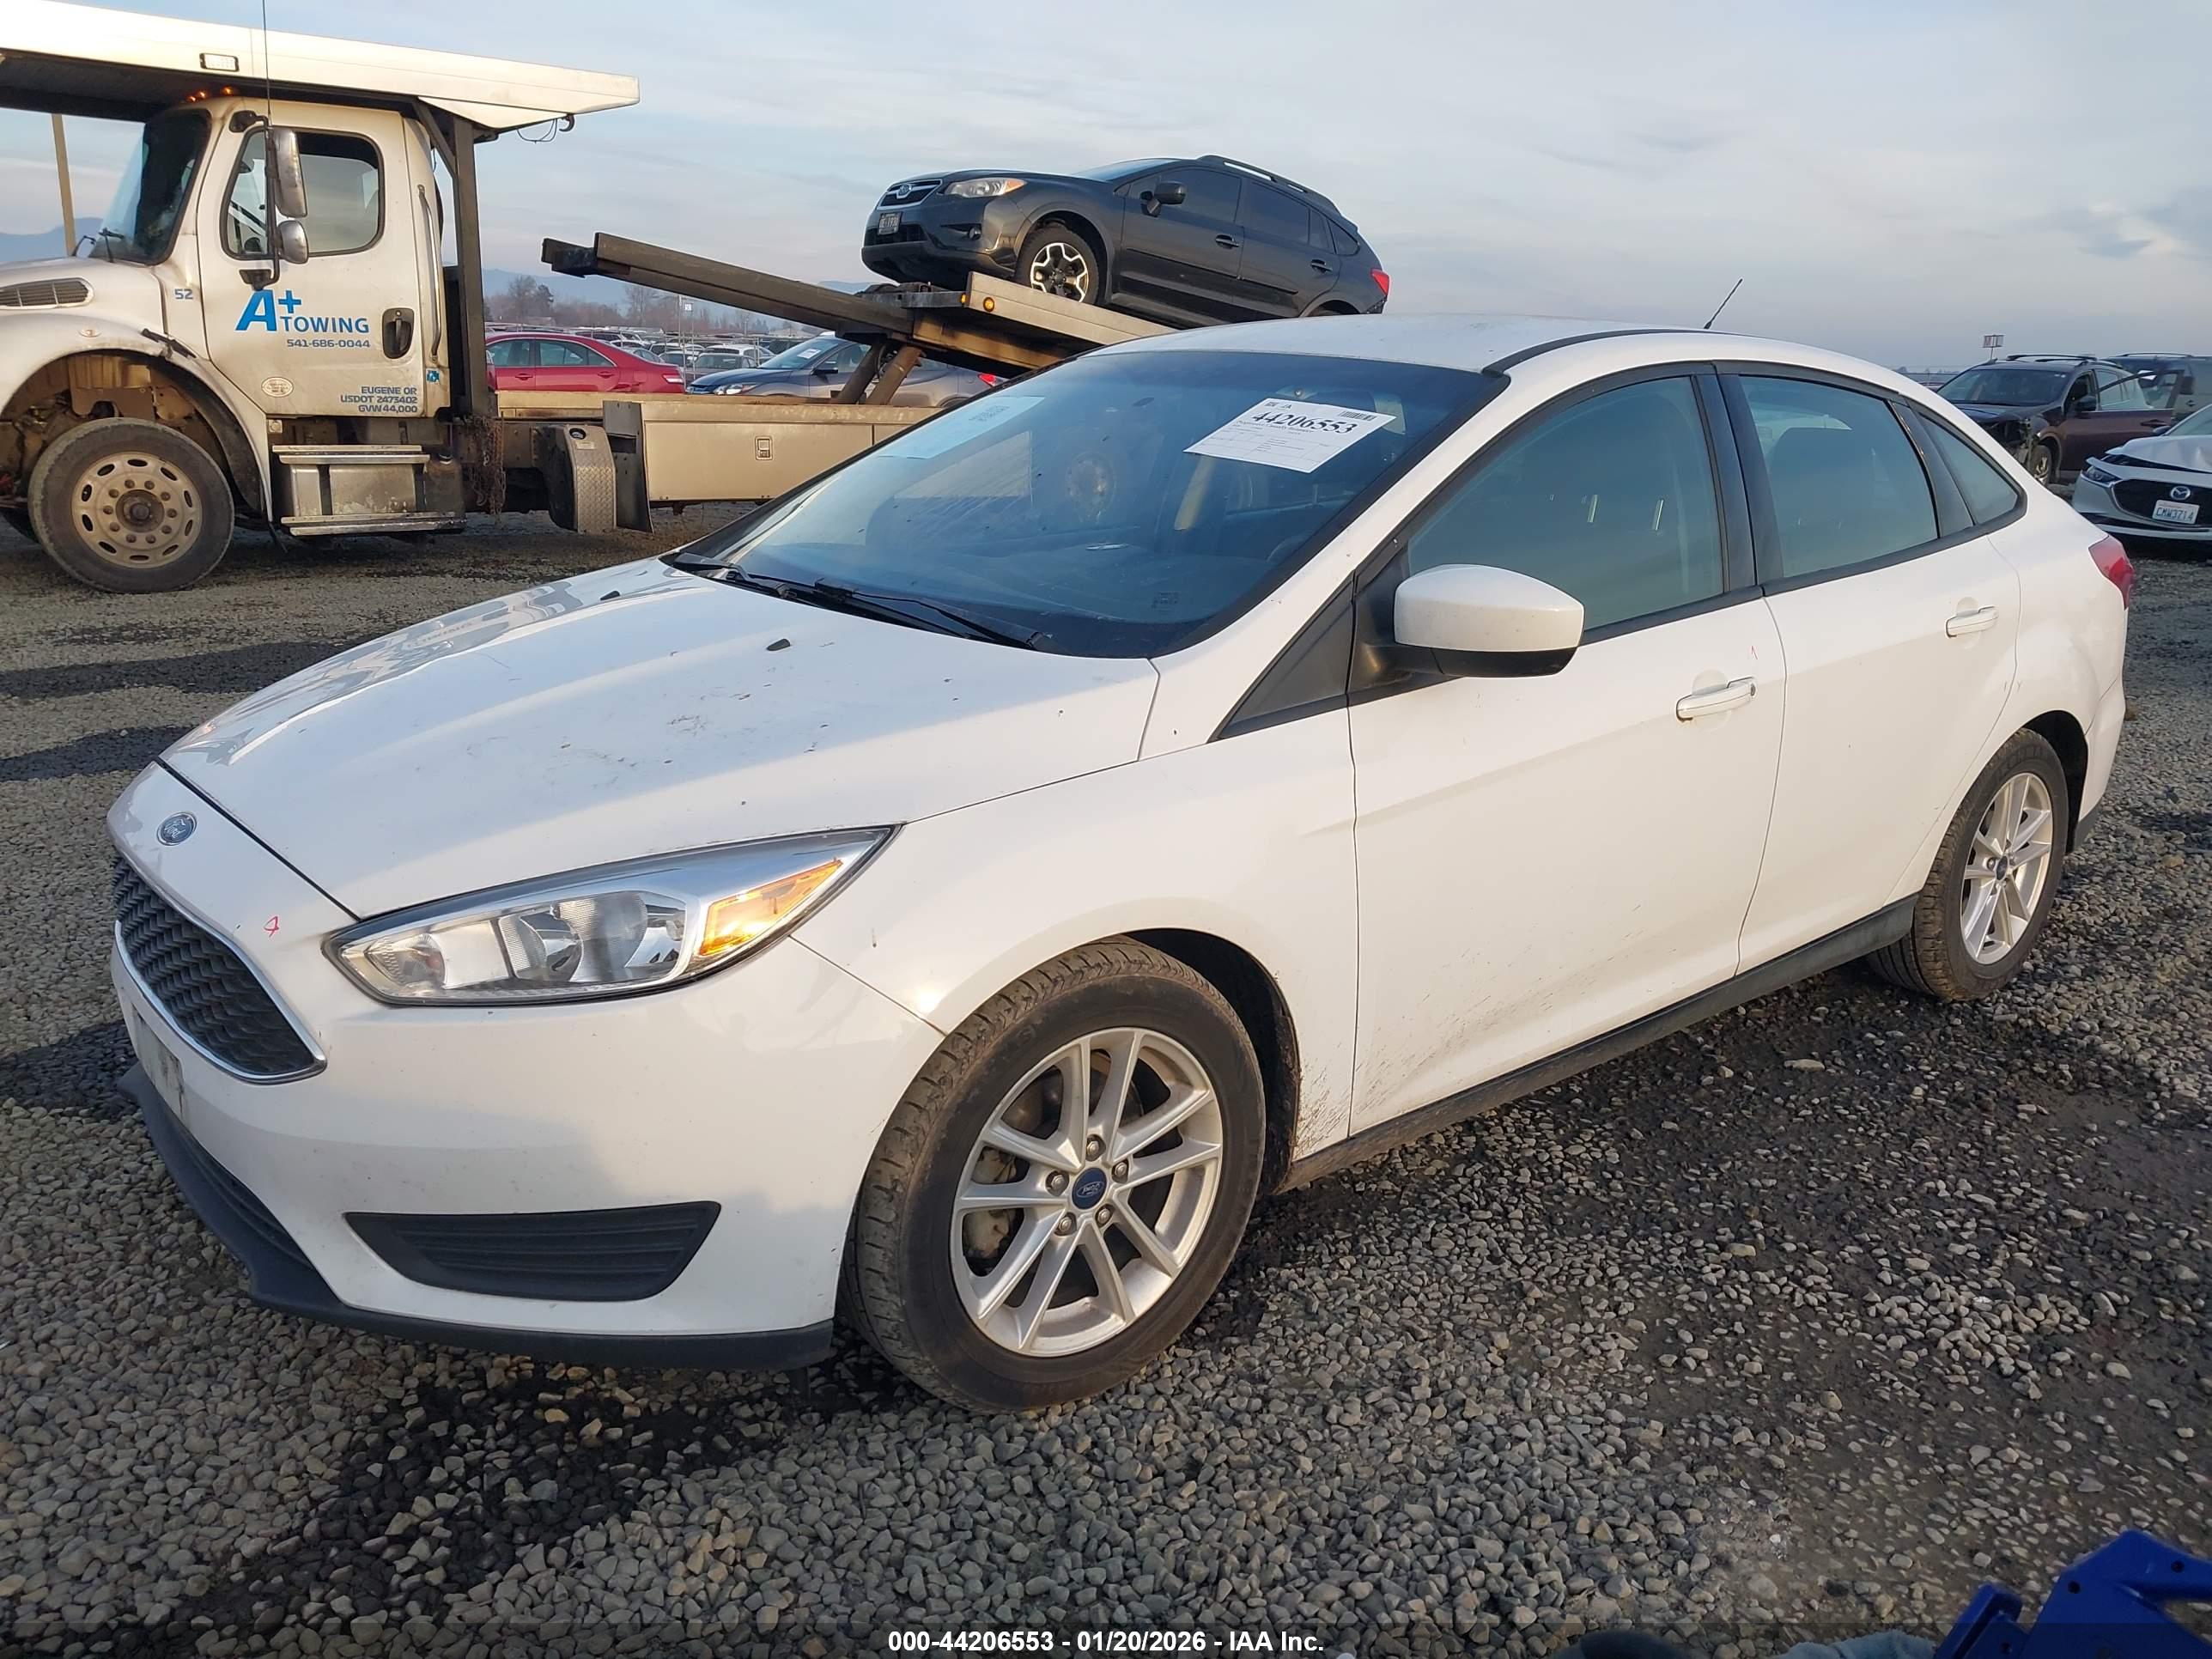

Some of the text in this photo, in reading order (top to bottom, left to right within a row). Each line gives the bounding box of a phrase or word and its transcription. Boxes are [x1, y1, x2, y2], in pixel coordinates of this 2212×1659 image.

[174, 288, 194, 300] 52
[235, 289, 302, 331] A+
[281, 316, 369, 333] TOWING
[287, 339, 370, 348] 541-686-0044
[403, 386, 417, 395] OR
[340, 394, 374, 404] USDOT
[358, 404, 418, 414] GVW 44,000
[1252, 411, 1358, 434] 44206553
